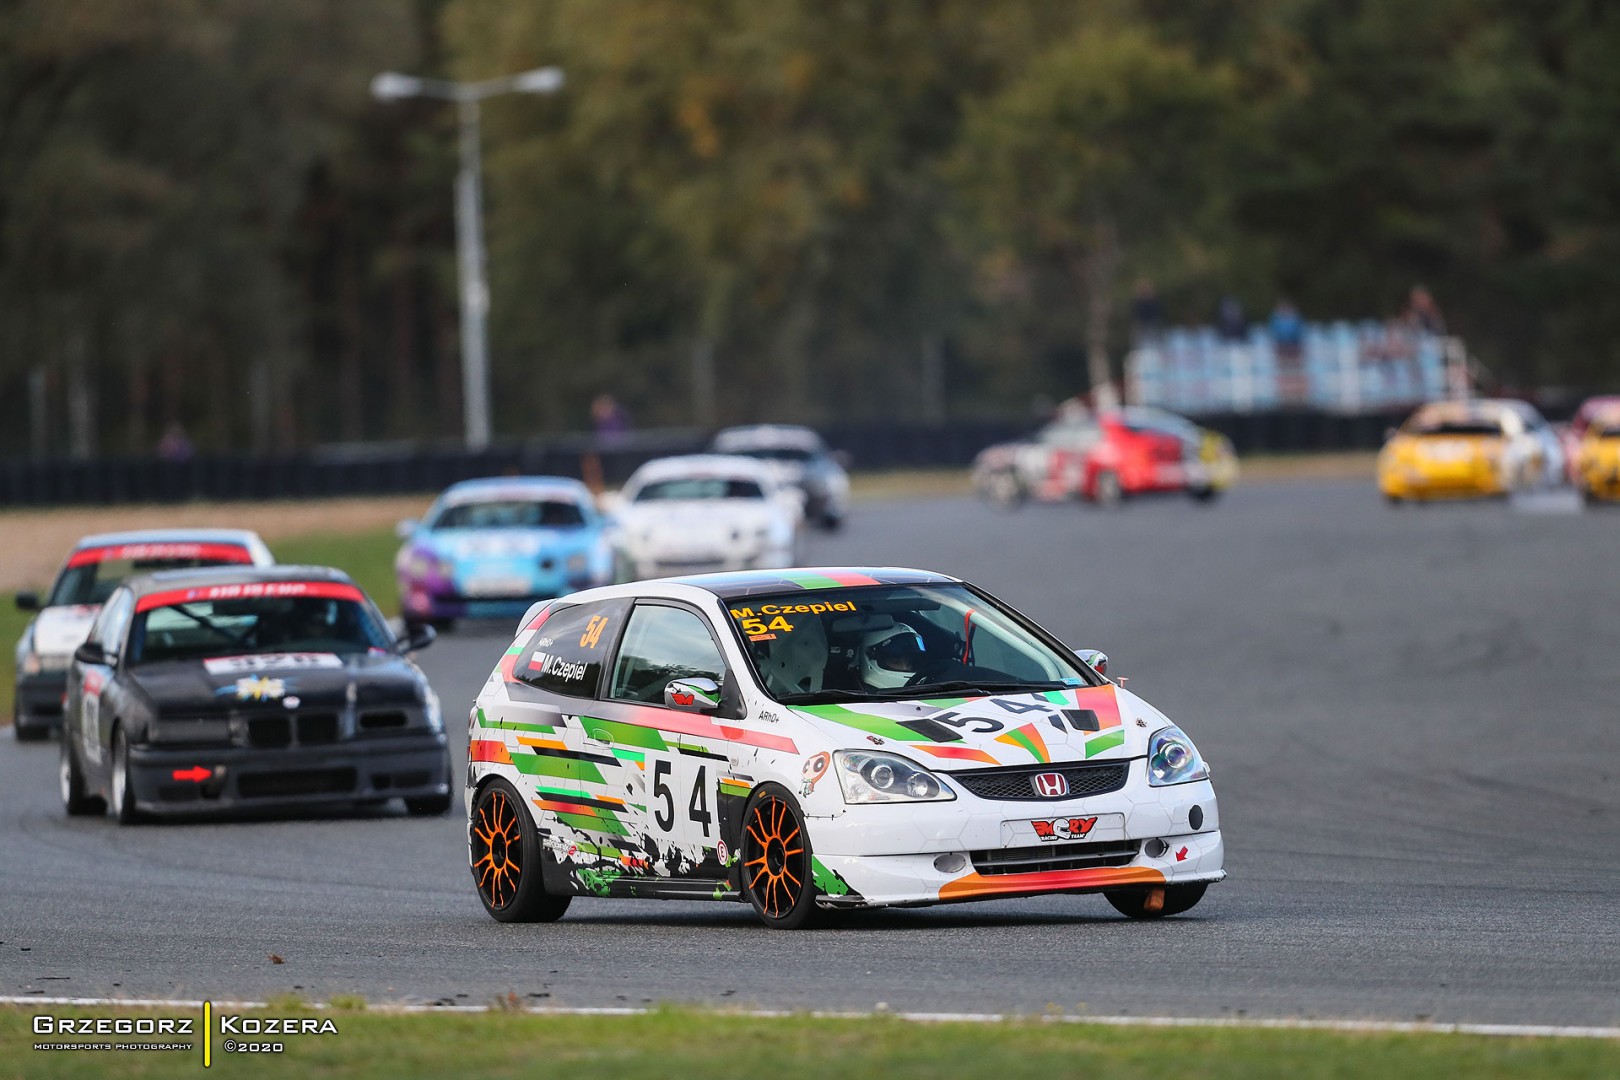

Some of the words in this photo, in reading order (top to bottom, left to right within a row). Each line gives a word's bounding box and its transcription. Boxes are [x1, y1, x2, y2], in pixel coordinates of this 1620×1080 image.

[730, 601, 857, 619] M.Czepiel
[580, 615, 608, 649] 54
[741, 615, 795, 636] 54
[541, 654, 588, 683] M.Czepiel
[932, 698, 1054, 733] 54
